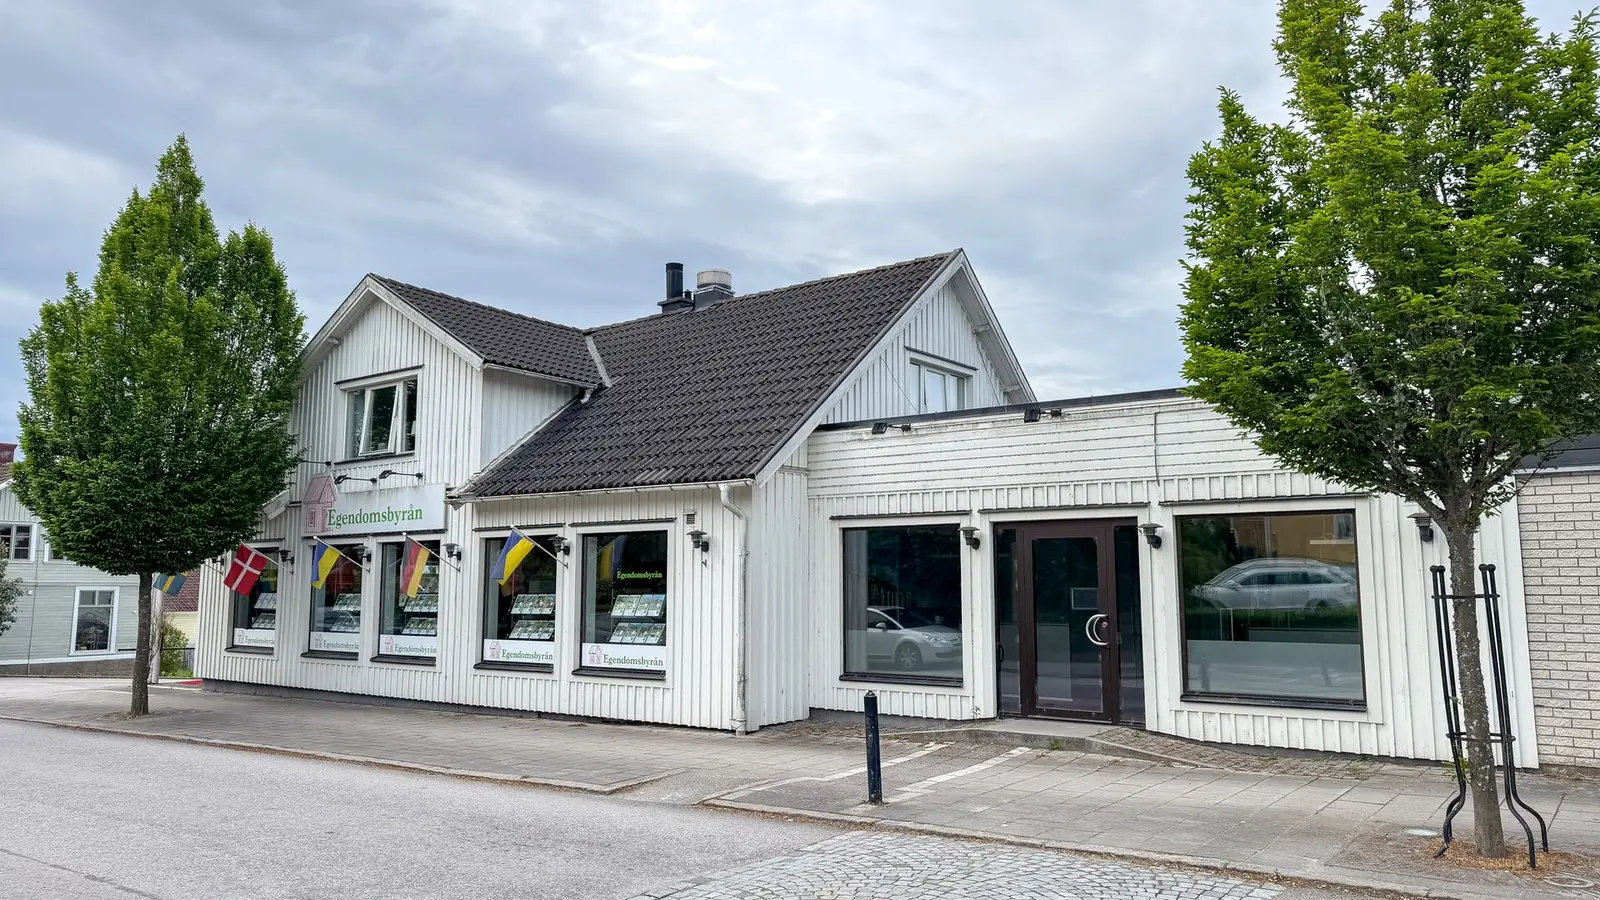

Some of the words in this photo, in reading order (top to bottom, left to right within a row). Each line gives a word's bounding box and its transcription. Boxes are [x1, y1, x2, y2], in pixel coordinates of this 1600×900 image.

[327, 503, 423, 529] Egendomsbyrån
[616, 570, 662, 580] Egendomsbyrån
[501, 649, 553, 661] Egendomsbyrån
[603, 654, 663, 667] Egendomsbyrån
